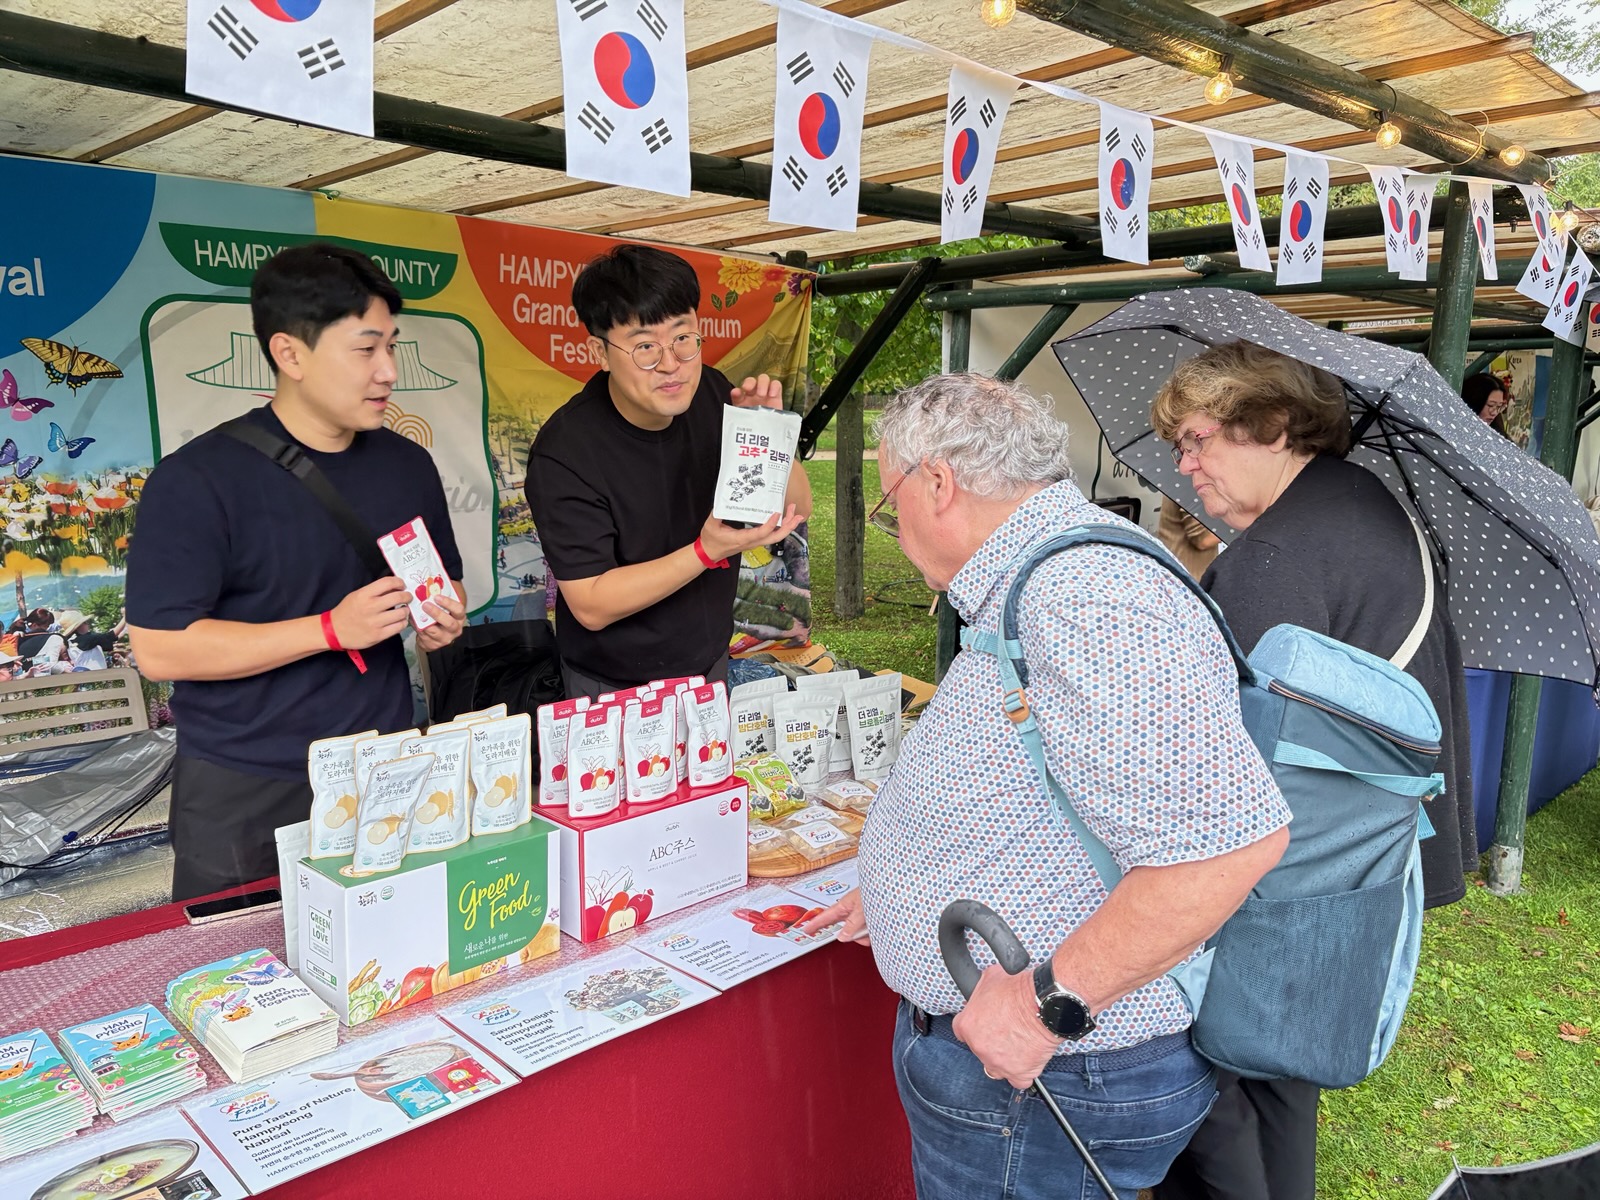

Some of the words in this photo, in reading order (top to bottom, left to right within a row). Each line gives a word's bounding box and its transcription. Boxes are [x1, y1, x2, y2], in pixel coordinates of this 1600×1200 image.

[194, 239, 288, 270] HAMPY
[499, 253, 589, 289] HAMPY
[736, 432, 746, 444] 더
[749, 434, 770, 448] 리얼
[738, 446, 760, 458] 고추
[738, 714, 746, 723] 더
[748, 712, 762, 722] 리얼
[858, 710, 866, 720] 더
[867, 707, 879, 717] 리얼
[637, 724, 665, 736] ABC주스
[786, 724, 794, 732] 더
[796, 721, 810, 732] 리얼
[480, 742, 506, 754] 온가족을
[508, 738, 521, 748] 위한
[580, 735, 610, 746] ABC주스
[444, 752, 460, 764] 위한
[485, 748, 518, 760] 도라지배즙
[649, 837, 696, 862] ABC주스
[458, 872, 520, 931] Green
[489, 880, 532, 929] Food
[310, 911, 331, 931] GREEN
[312, 927, 328, 945] LOVE
[680, 948, 700, 960] Fresh
[687, 944, 732, 964] Hampyeong
[696, 958, 712, 968] ABC
[713, 950, 732, 960] Juice
[254, 988, 286, 1000] Ham
[260, 992, 311, 1008] Together
[102, 1020, 129, 1031] HAM
[486, 1010, 510, 1024] Food
[490, 1021, 522, 1037] Savory
[522, 1009, 558, 1024] Delight,
[96, 1020, 143, 1040] PYEONG
[496, 1018, 554, 1042] Hampyeong
[504, 1035, 524, 1046] Gim
[524, 1025, 555, 1042] Bugak
[0, 1046, 28, 1060] ONG
[220, 1094, 270, 1115] Korean
[232, 1122, 262, 1138] Pure
[263, 1108, 298, 1124] Taste
[299, 1102, 312, 1112] of
[312, 1087, 356, 1106] Nature,
[234, 1100, 266, 1118] Food
[238, 1110, 314, 1144] Hampyeong
[244, 1128, 292, 1150] Nabisal
[251, 1148, 270, 1158] Goût
[270, 1144, 283, 1153] pur
[300, 1126, 326, 1140] nature,
[254, 1150, 282, 1163] Nabisal
[282, 1146, 292, 1154] de
[292, 1128, 335, 1149] Hampyeong
[266, 1153, 321, 1178] HAMPEYEONG
[320, 1138, 356, 1156] PREMIUM
[355, 1127, 382, 1141] K-FOOD
[260, 1155, 282, 1170] 자연의
